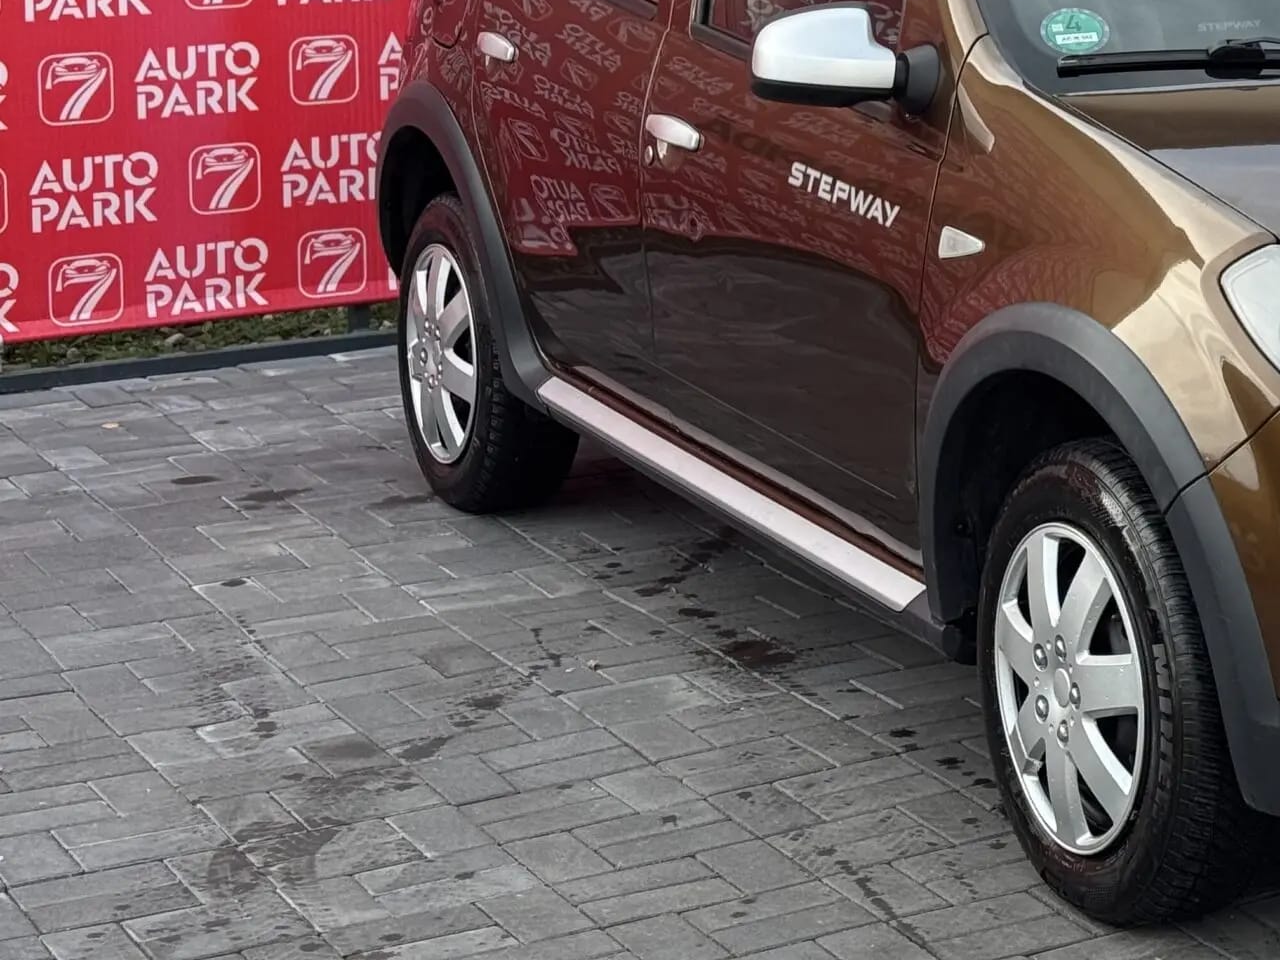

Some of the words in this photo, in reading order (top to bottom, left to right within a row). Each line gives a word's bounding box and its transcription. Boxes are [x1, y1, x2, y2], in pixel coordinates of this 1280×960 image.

[1065, 13, 1082, 32] 4
[1198, 19, 1263, 33] STEPWAY
[135, 42, 260, 82] AUTO
[137, 77, 258, 120] PARK
[29, 151, 158, 195] AUTO
[787, 159, 902, 229] STEPWAY
[32, 187, 157, 233] PARK
[144, 238, 268, 281] AUTO
[146, 272, 268, 318] PARK
